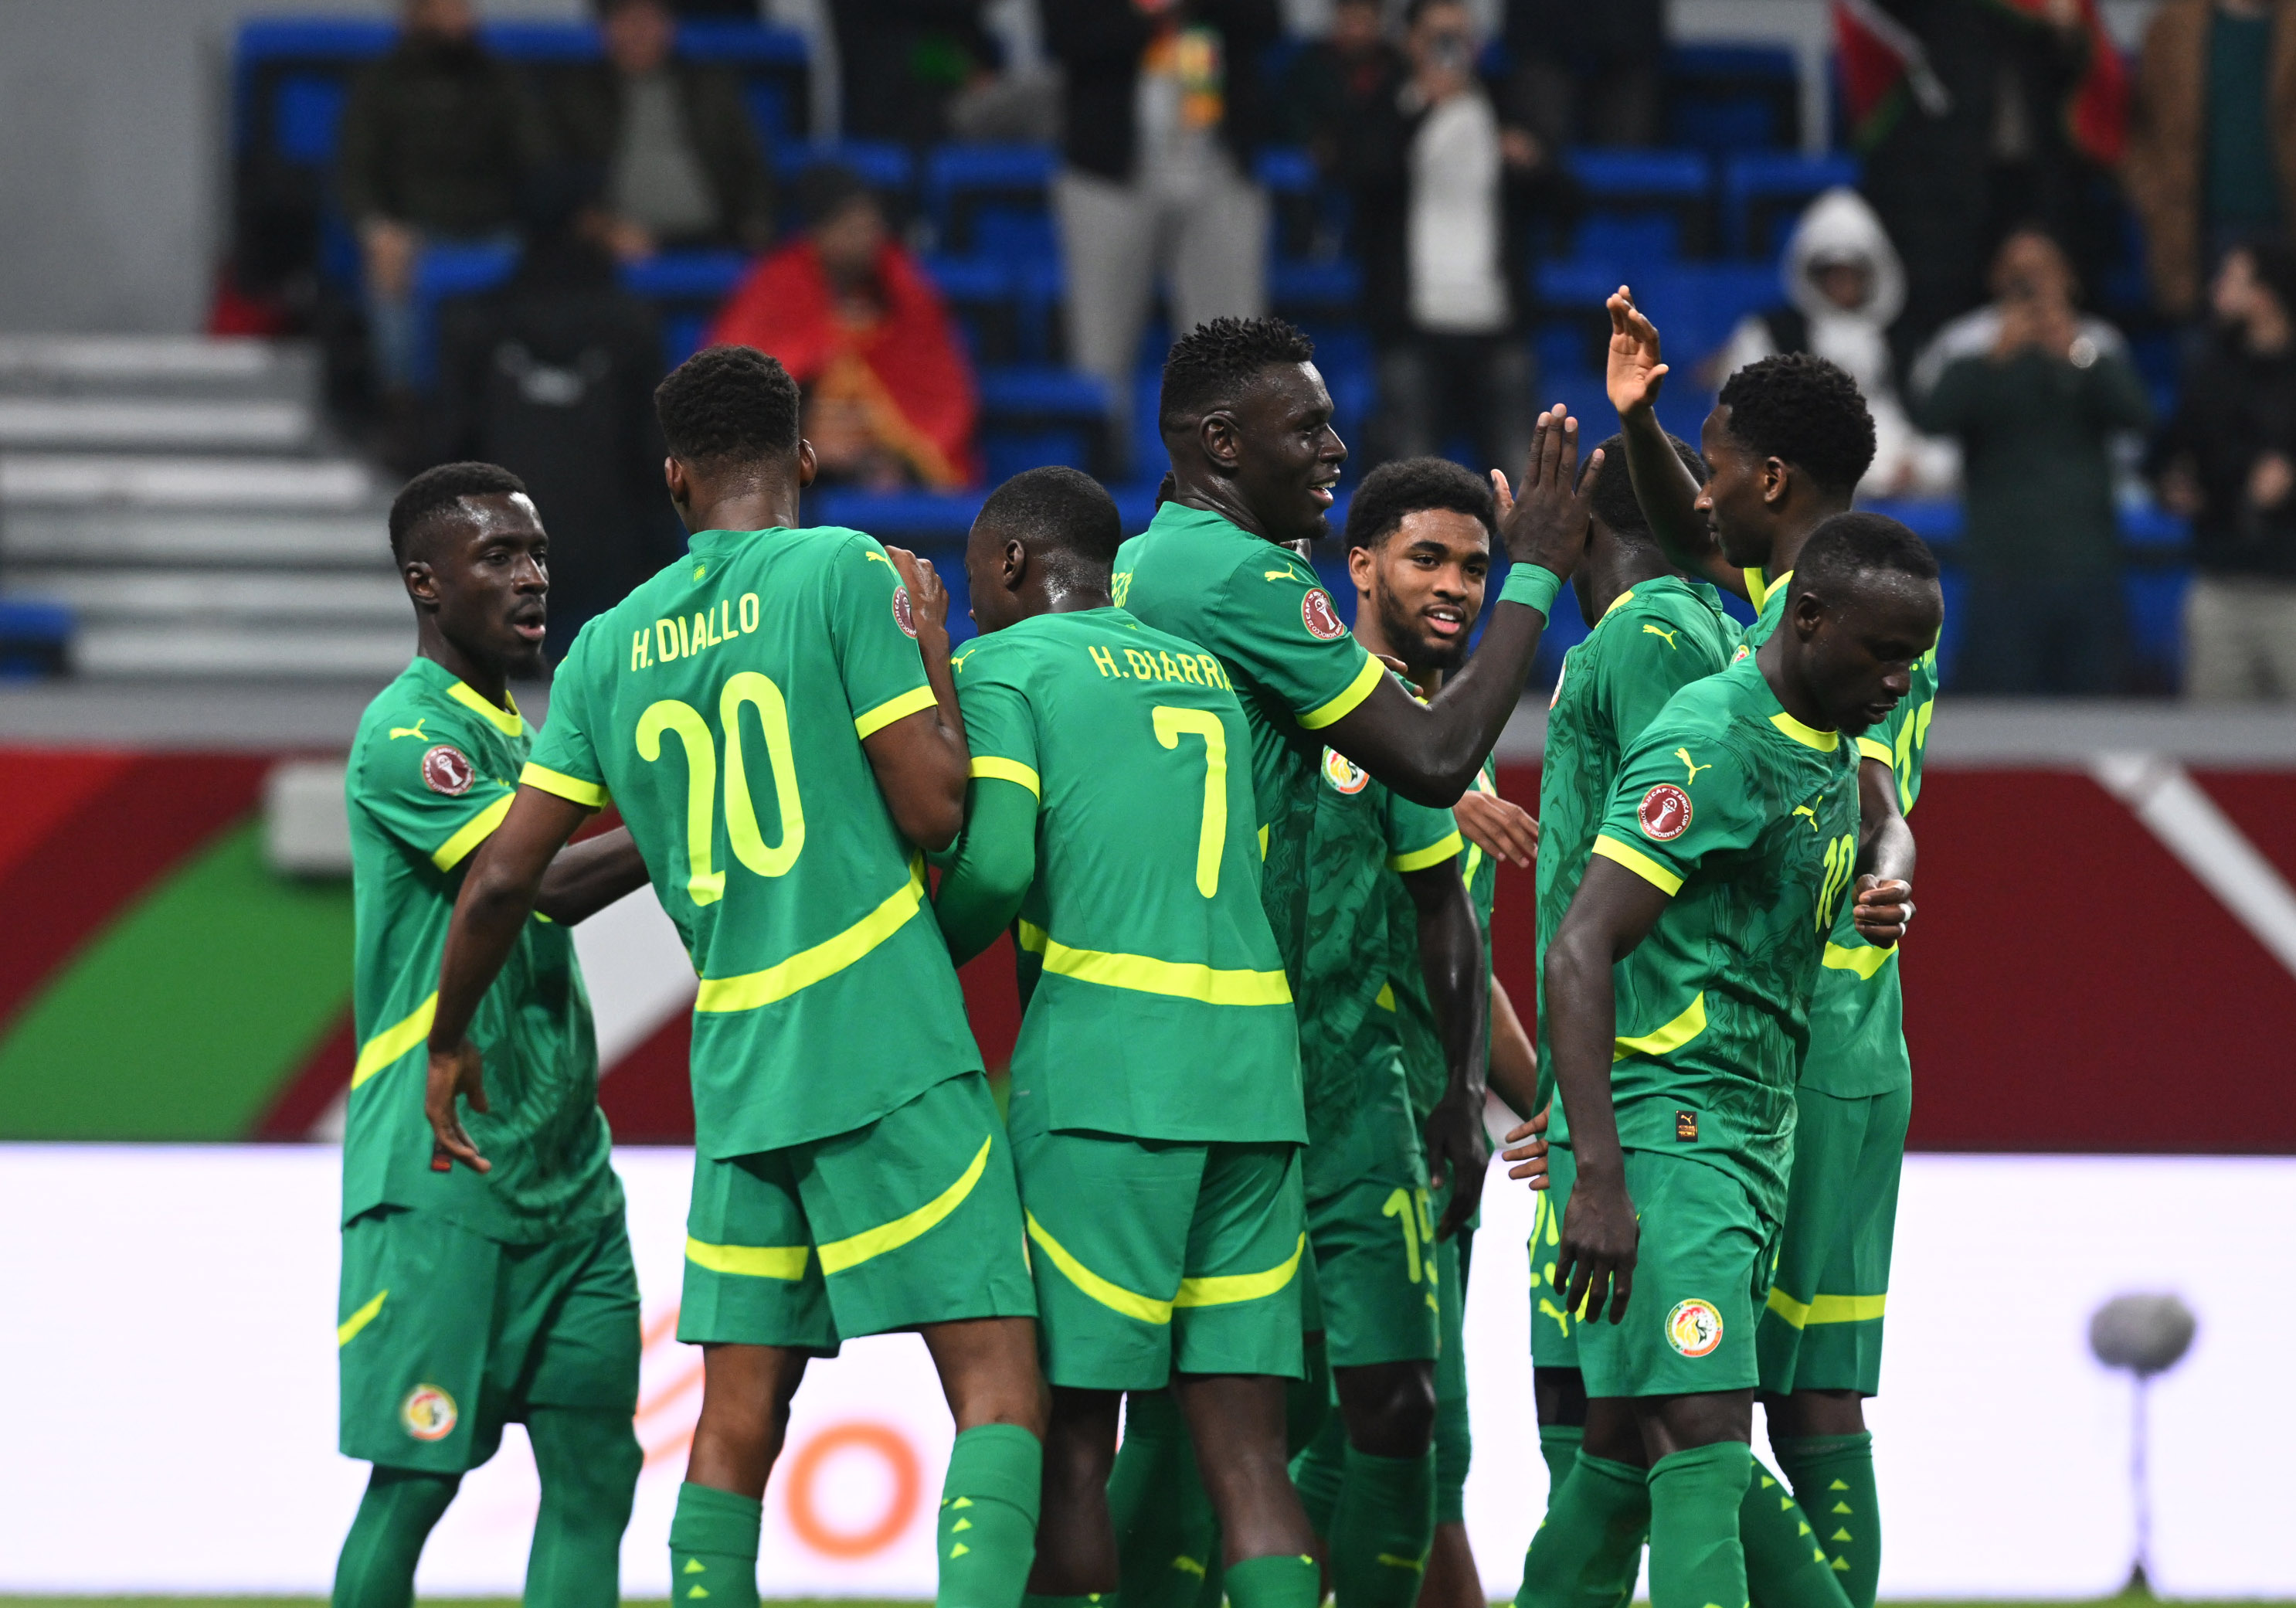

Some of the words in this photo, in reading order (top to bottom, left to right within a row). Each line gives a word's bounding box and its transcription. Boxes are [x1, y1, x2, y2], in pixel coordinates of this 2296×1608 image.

[630, 592, 759, 671] H.DIALLO
[898, 617, 917, 635] OROCCO
[635, 671, 806, 907] 20
[1151, 705, 1228, 898] 7
[1677, 794, 1690, 814] AFRICA
[1650, 829, 1676, 838] NATIONS
[1681, 814, 1690, 826] CUP
[1815, 834, 1854, 933] 10
